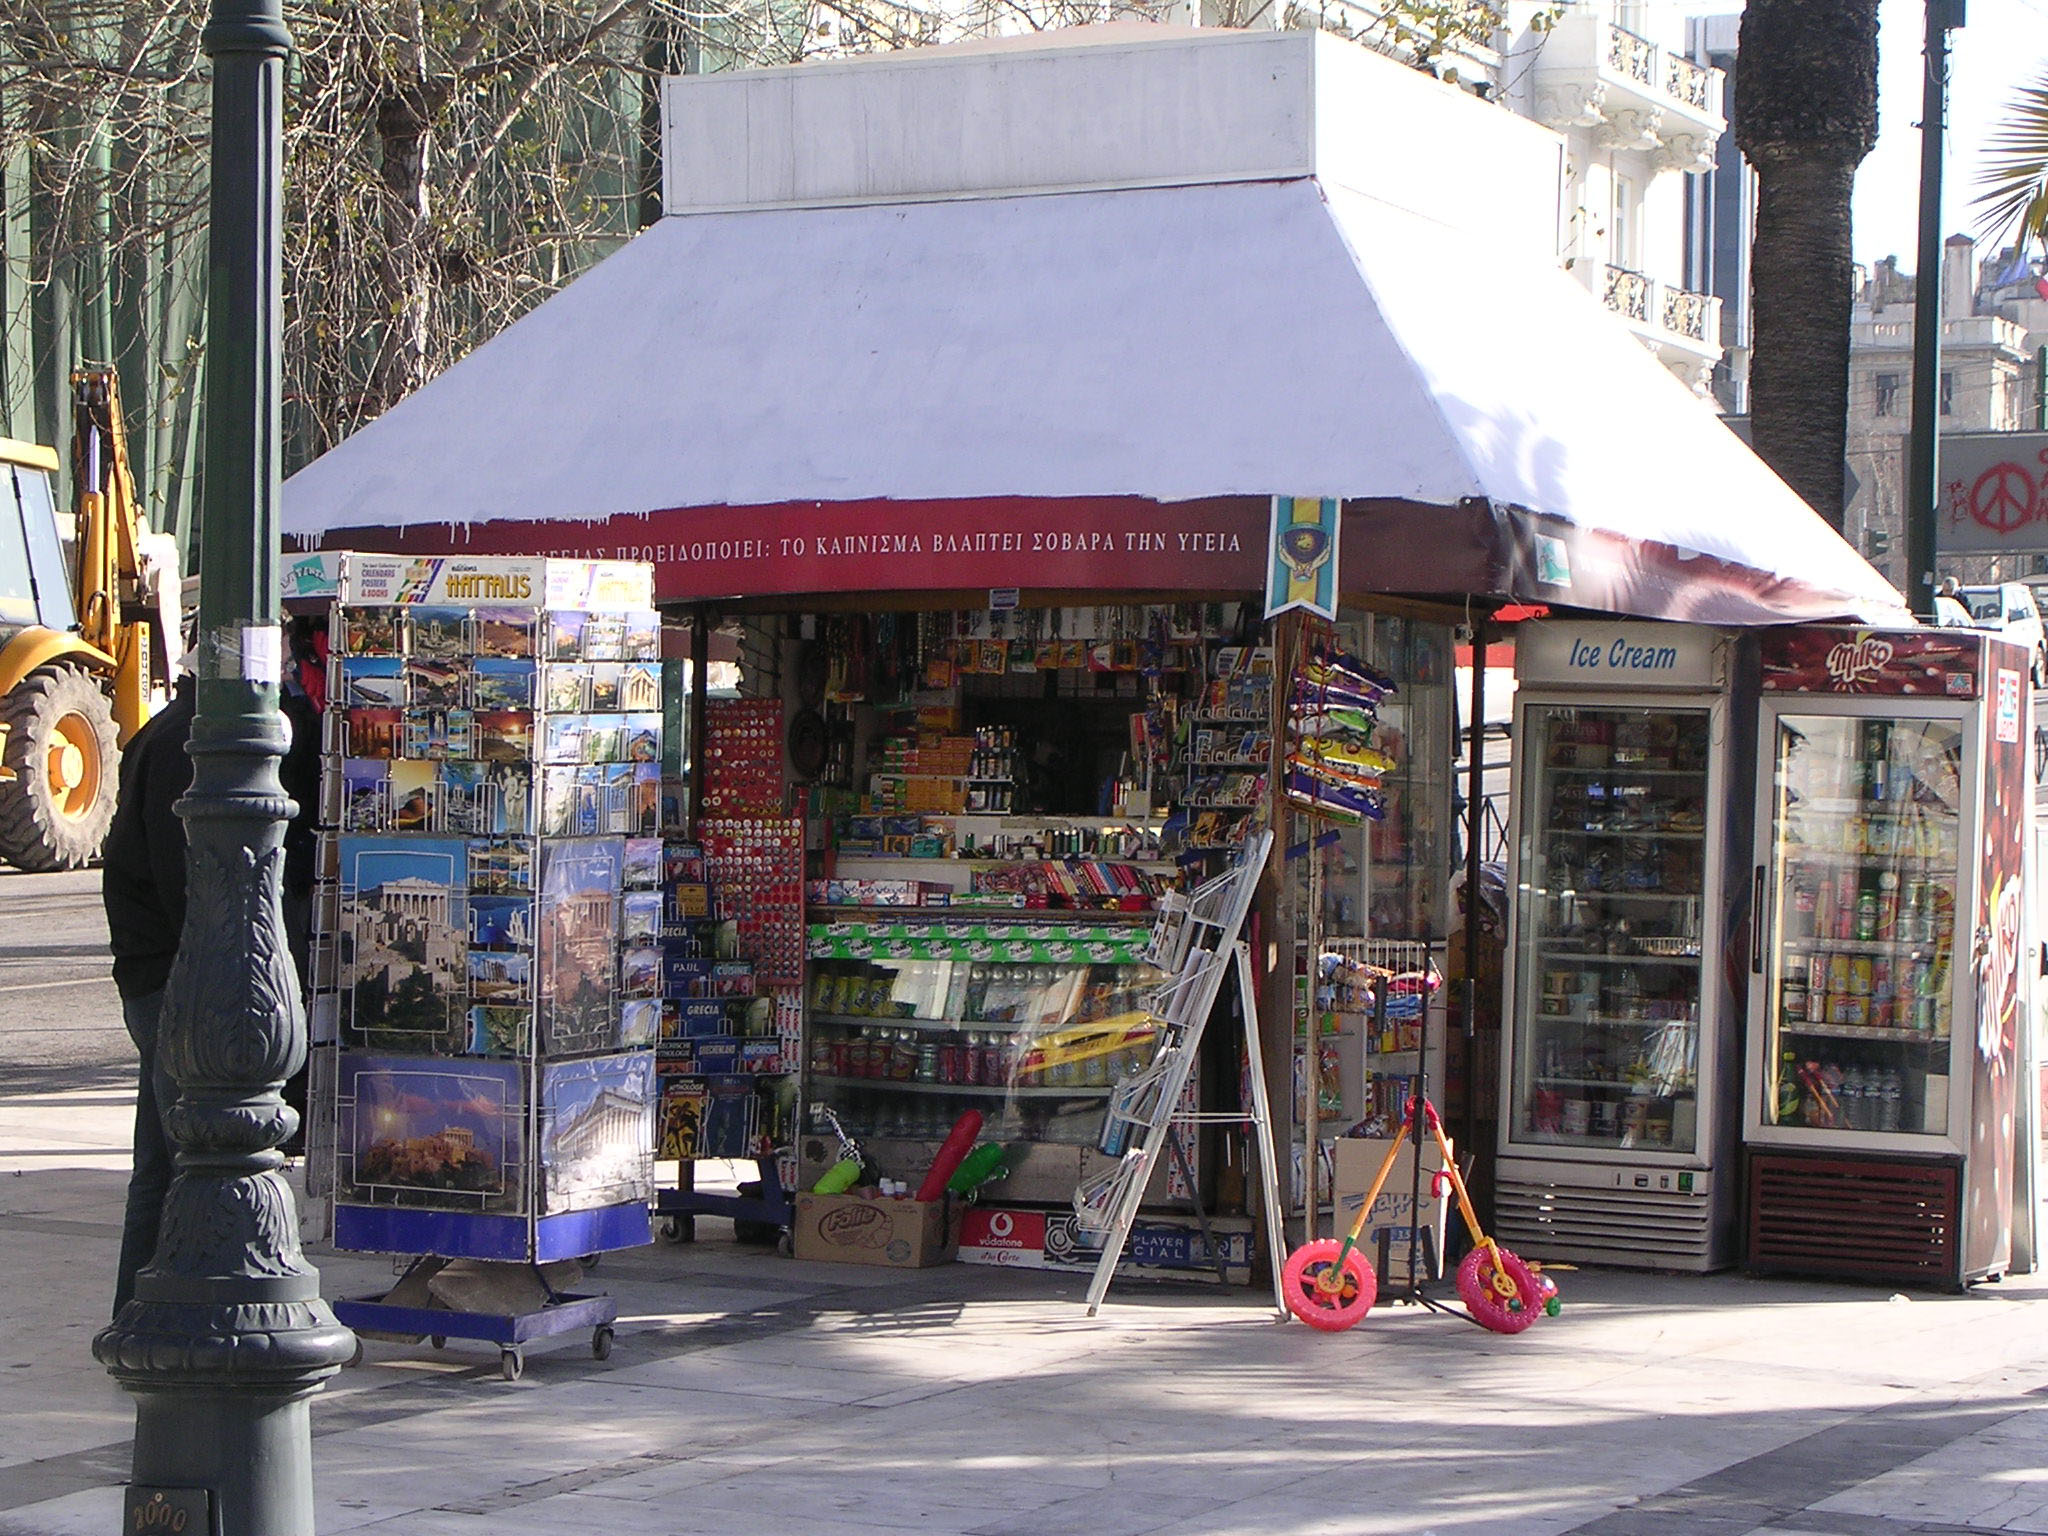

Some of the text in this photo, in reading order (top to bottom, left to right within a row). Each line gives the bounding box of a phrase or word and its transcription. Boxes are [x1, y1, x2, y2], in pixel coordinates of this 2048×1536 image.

[616, 540, 770, 563] ΠΡΟΕΙΔΟΠΟΙΕΙ:
[780, 537, 805, 556] ΤΟ
[816, 534, 922, 555] ΚΑΠΝΙΣΜΑ
[932, 532, 1023, 553] ΒΛΑΠΤΕΙ
[1032, 532, 1115, 551] ΣΟΒΑΡΑ
[1125, 532, 1167, 551] ΤΗΝ
[1178, 532, 1242, 552] ΥΓΕΙΑ
[361, 569, 396, 578] CALENDARS
[1569, 638, 1677, 669] Ice Cream
[672, 962, 700, 972] PAUL
[686, 1004, 720, 1016] GRECIA
[979, 1236, 1023, 1248] vodafone
[1132, 1235, 1184, 1248] PLAYER
[1133, 1246, 1184, 1259] CIAL
